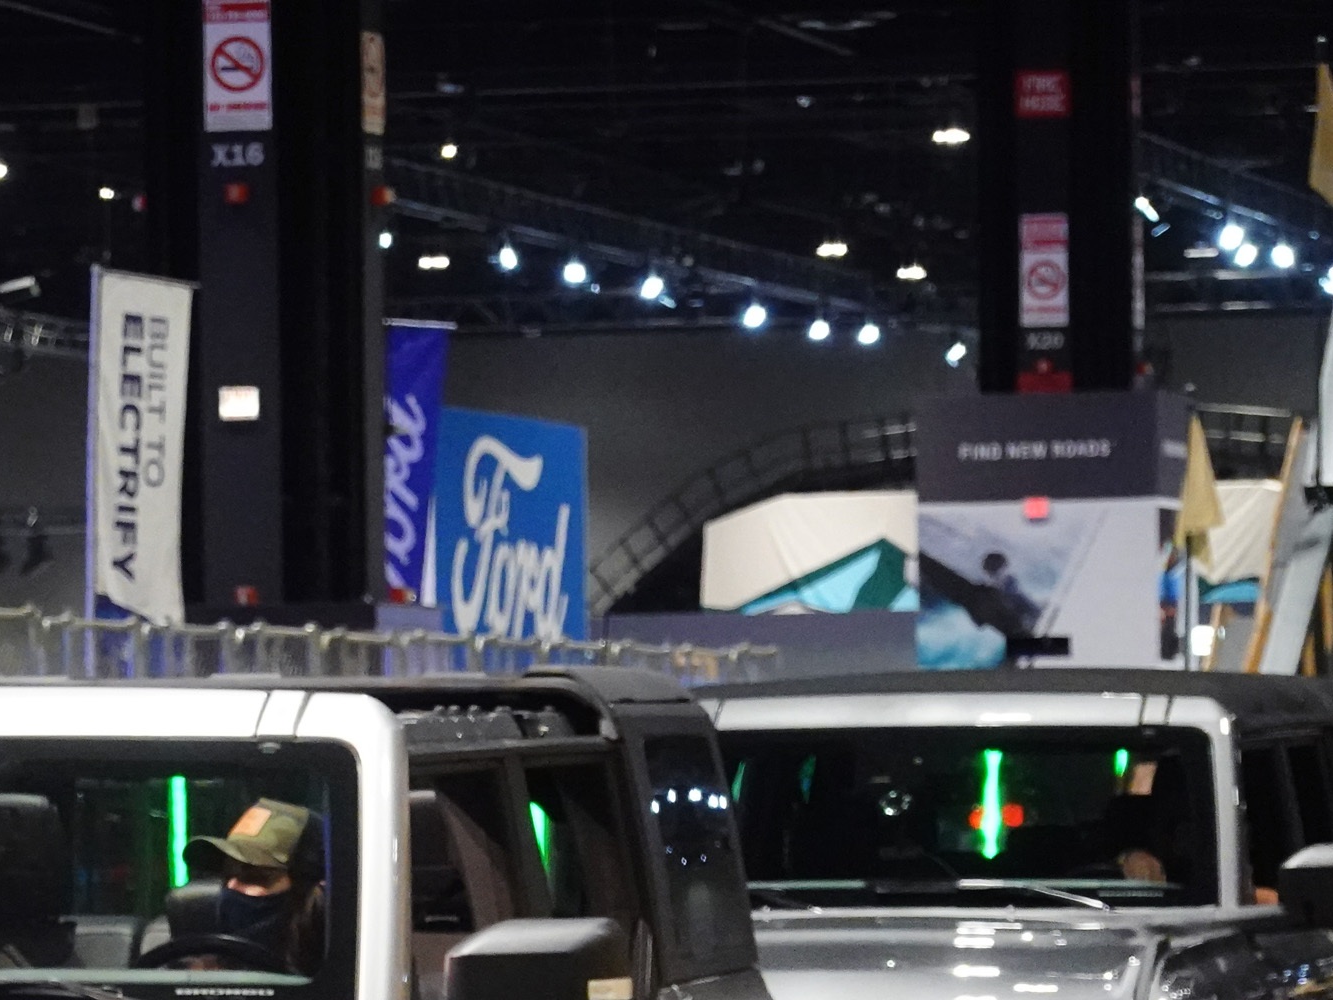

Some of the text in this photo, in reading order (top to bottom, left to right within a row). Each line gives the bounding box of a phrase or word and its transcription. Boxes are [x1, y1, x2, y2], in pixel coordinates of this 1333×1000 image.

[211, 142, 265, 167] X16
[112, 313, 144, 582] ELECTRIFY
[142, 314, 170, 488] BUILT TO
[957, 438, 1111, 461] FIND NEW ROADS
[450, 434, 572, 642] Ford
